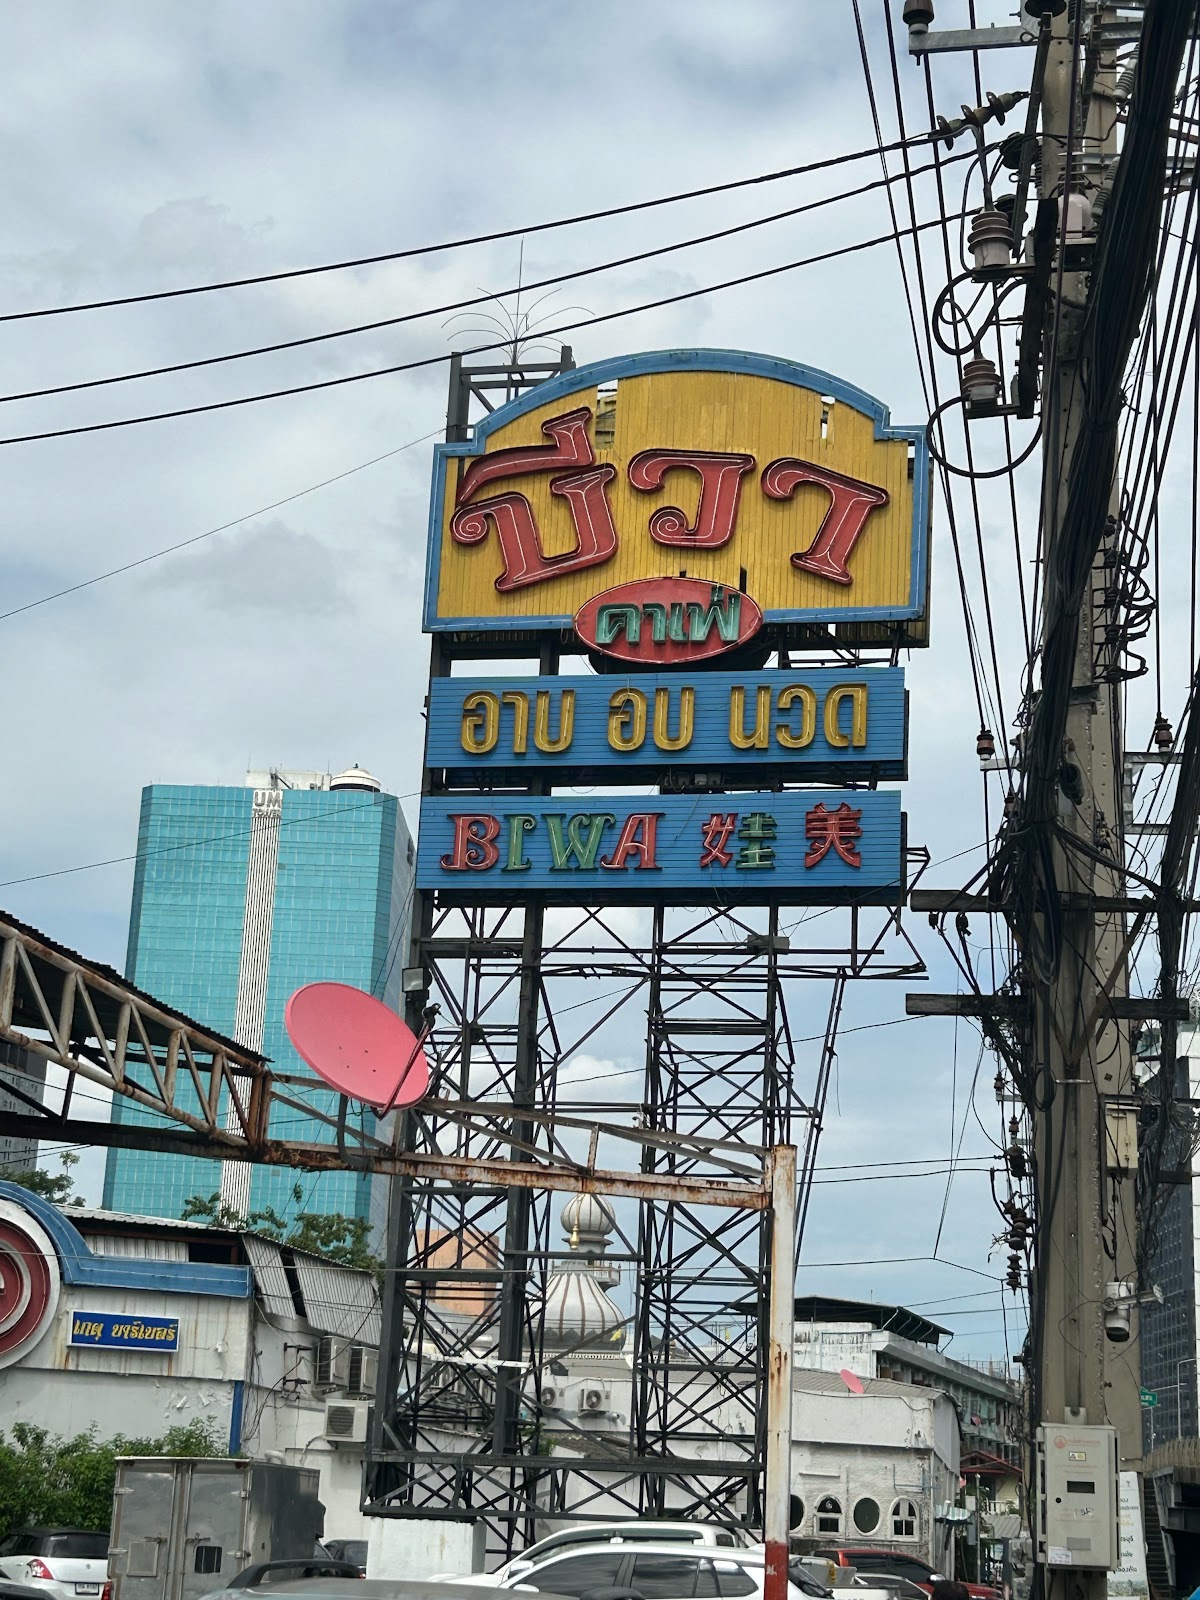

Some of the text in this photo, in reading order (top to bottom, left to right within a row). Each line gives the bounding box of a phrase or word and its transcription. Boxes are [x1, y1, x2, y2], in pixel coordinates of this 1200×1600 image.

[451, 406, 890, 592] บีวา
[595, 583, 741, 644] คาเฟ่
[460, 683, 867, 754] อาบ อบ นวด
[254, 791, 281, 807] UM
[440, 812, 666, 872] BIWA
